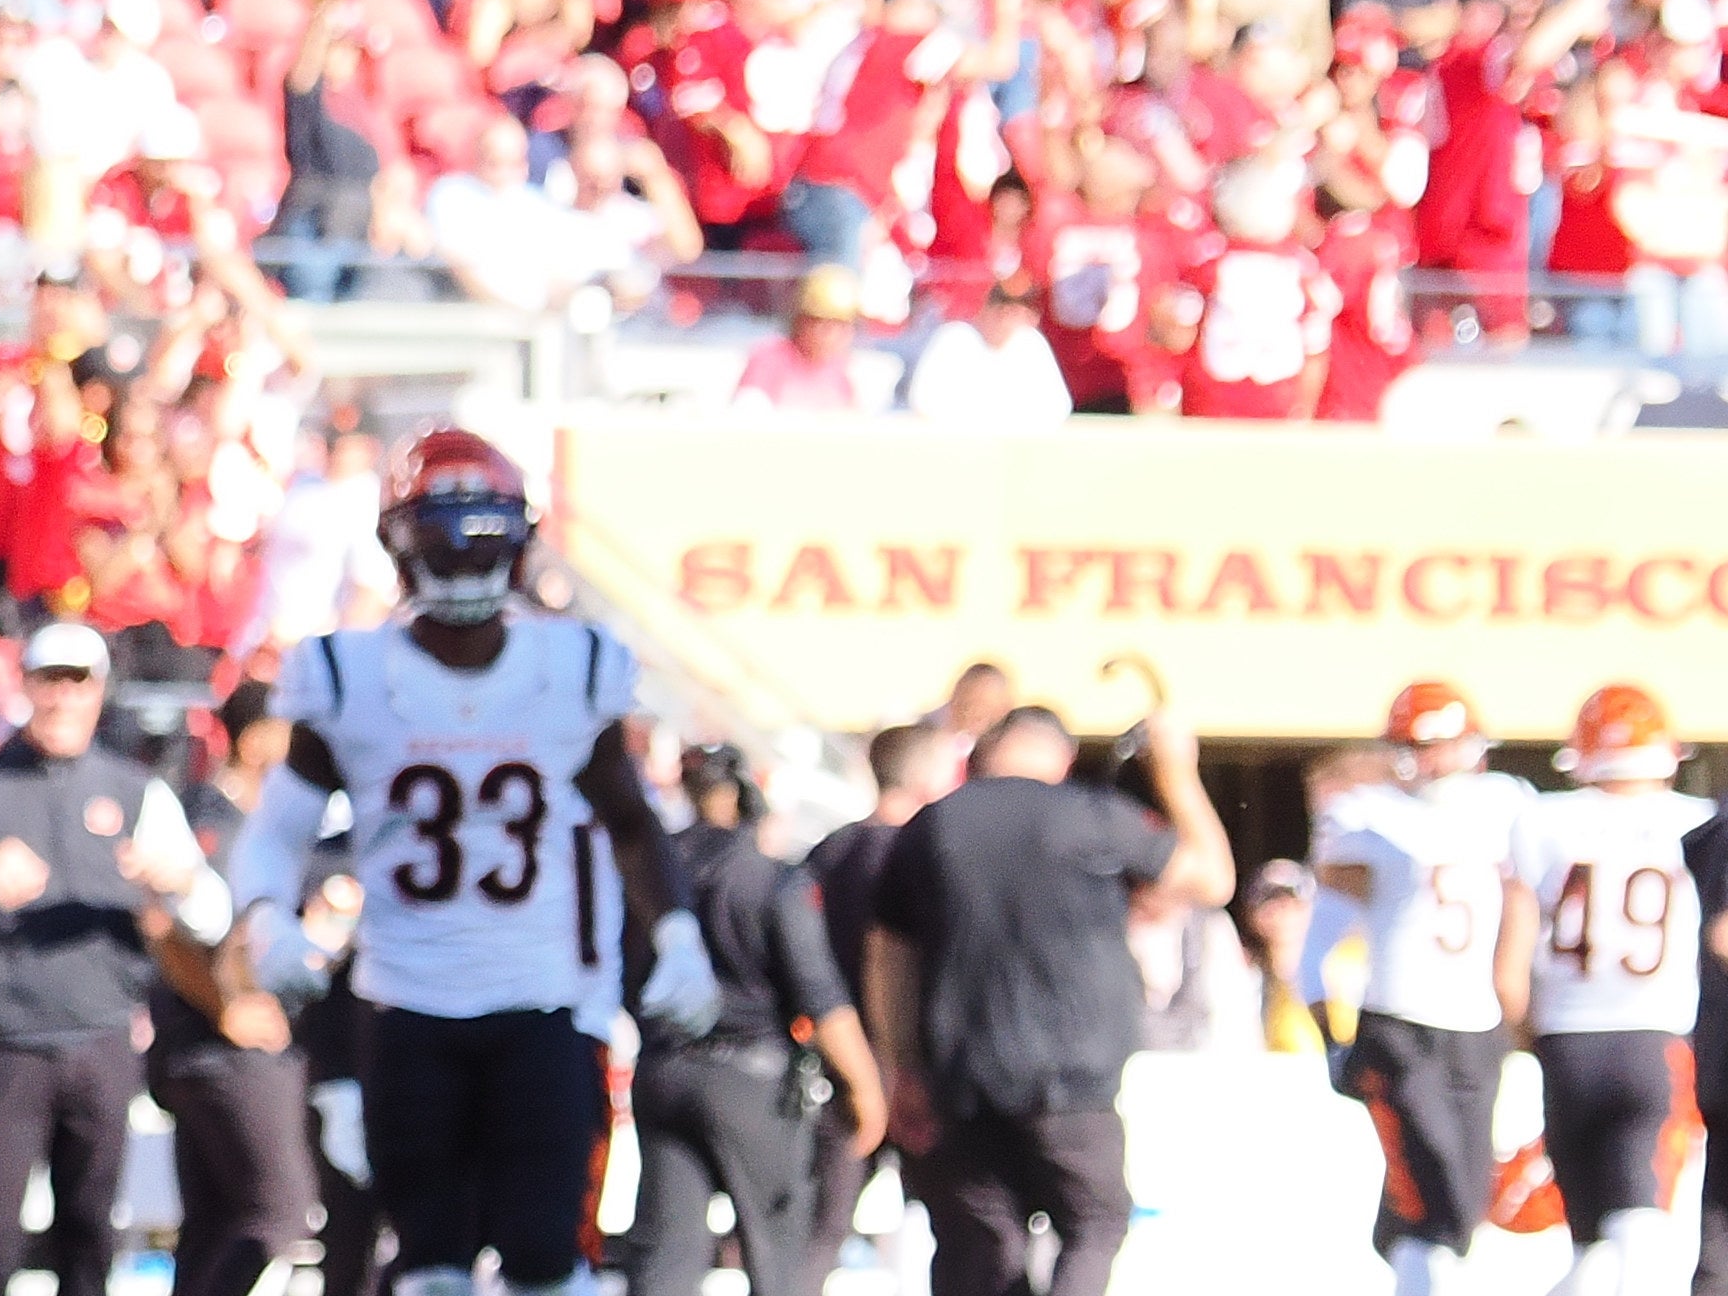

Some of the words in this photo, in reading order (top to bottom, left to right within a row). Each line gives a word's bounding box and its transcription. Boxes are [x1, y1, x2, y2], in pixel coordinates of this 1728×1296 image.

[677, 541, 964, 612] SAN
[387, 762, 548, 905] 33
[1550, 861, 1672, 977] 49
